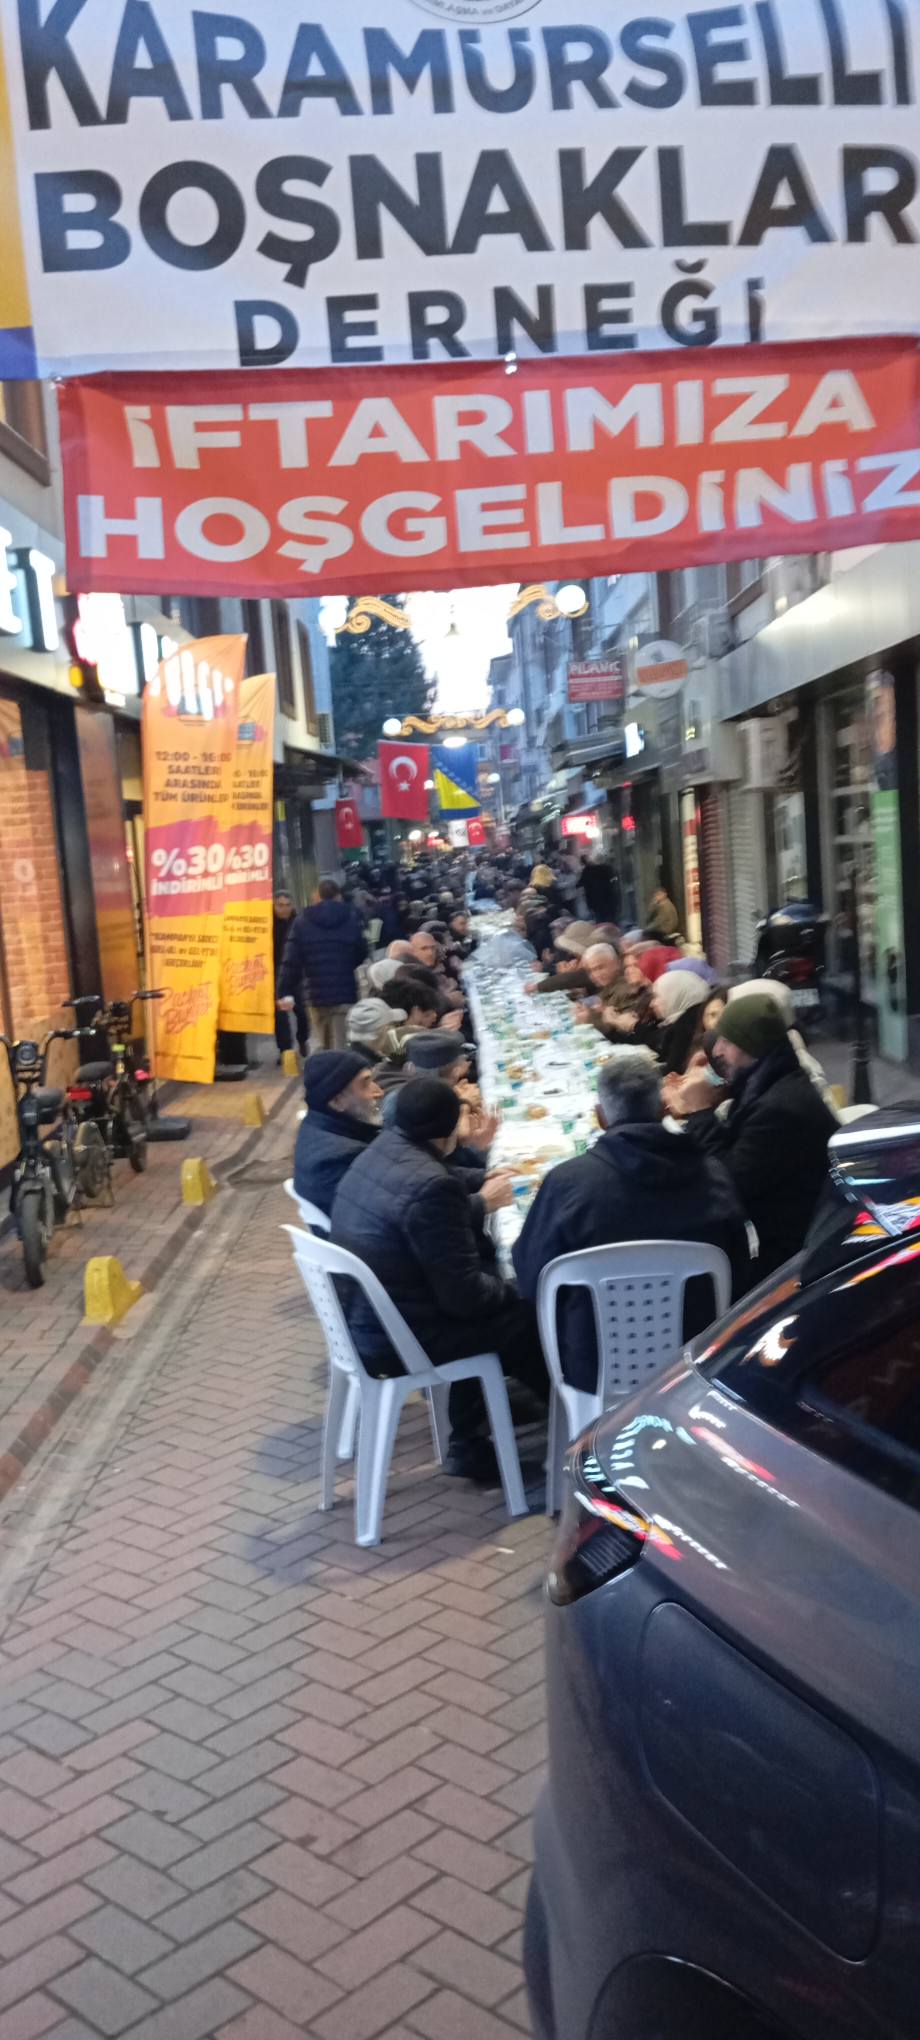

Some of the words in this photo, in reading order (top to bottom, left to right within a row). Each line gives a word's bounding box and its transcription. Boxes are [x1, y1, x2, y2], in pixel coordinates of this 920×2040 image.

[34, 143, 919, 289] BOŞNAKLAR
[234, 258, 766, 368] DERNEĞİ
[123, 369, 877, 470] İFTARIMIZA
[77, 448, 920, 575] HOŞGELDİNİZ
[150, 842, 226, 878] %30
